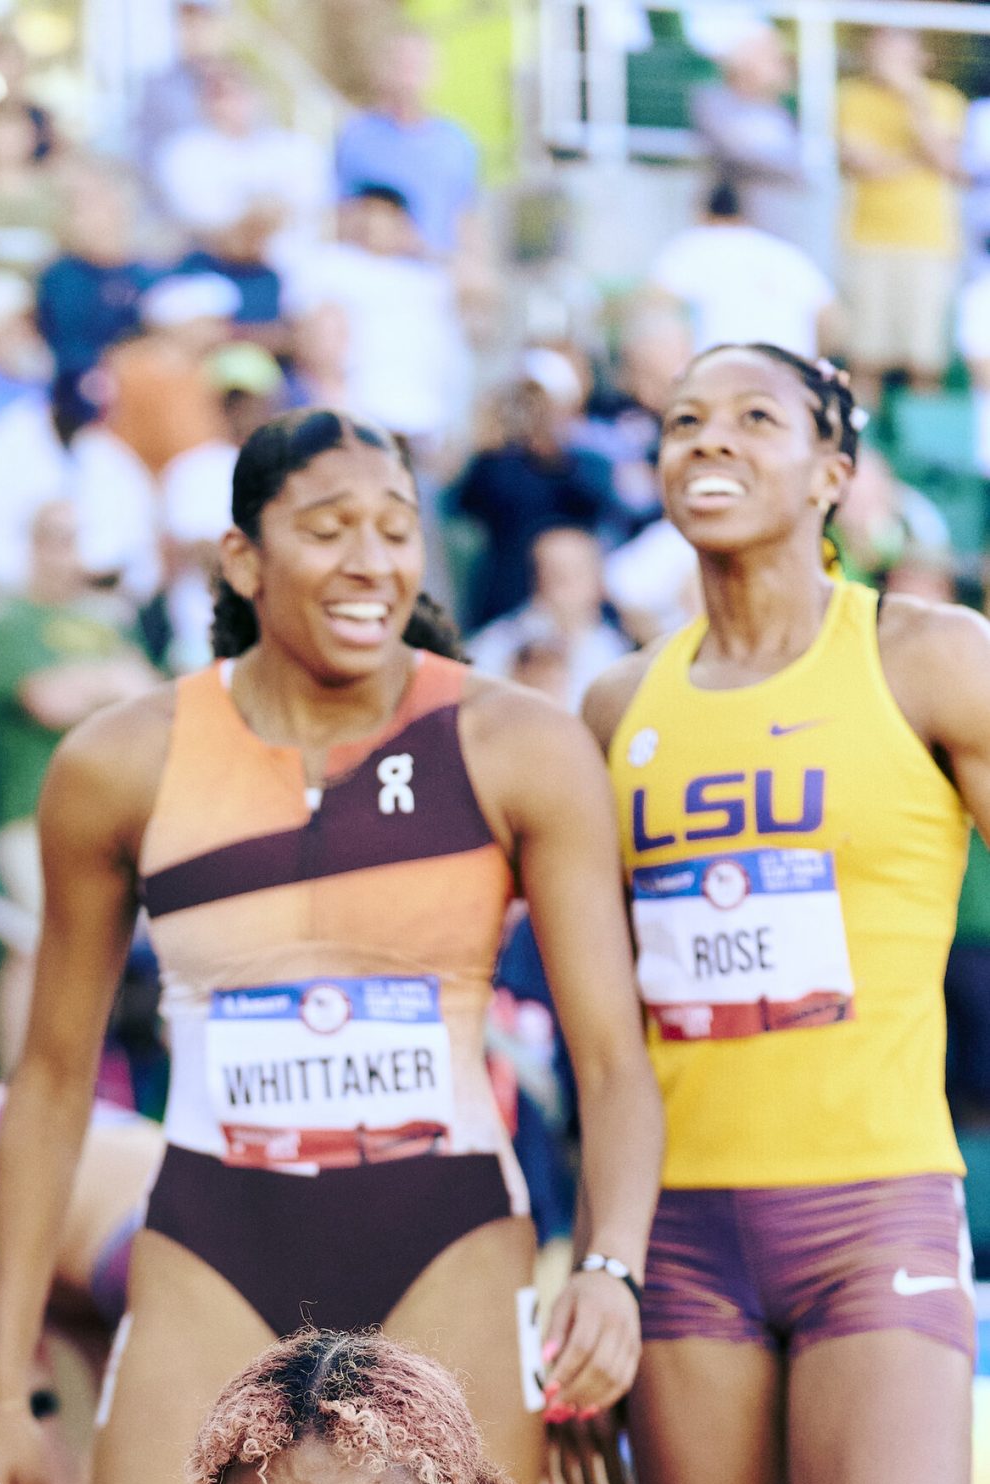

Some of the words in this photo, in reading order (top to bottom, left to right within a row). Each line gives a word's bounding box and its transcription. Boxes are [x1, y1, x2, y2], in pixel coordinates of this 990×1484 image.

[632, 768, 825, 853] LSU
[693, 926, 776, 981] ROSE
[223, 1048, 436, 1106] WHITTAKER
